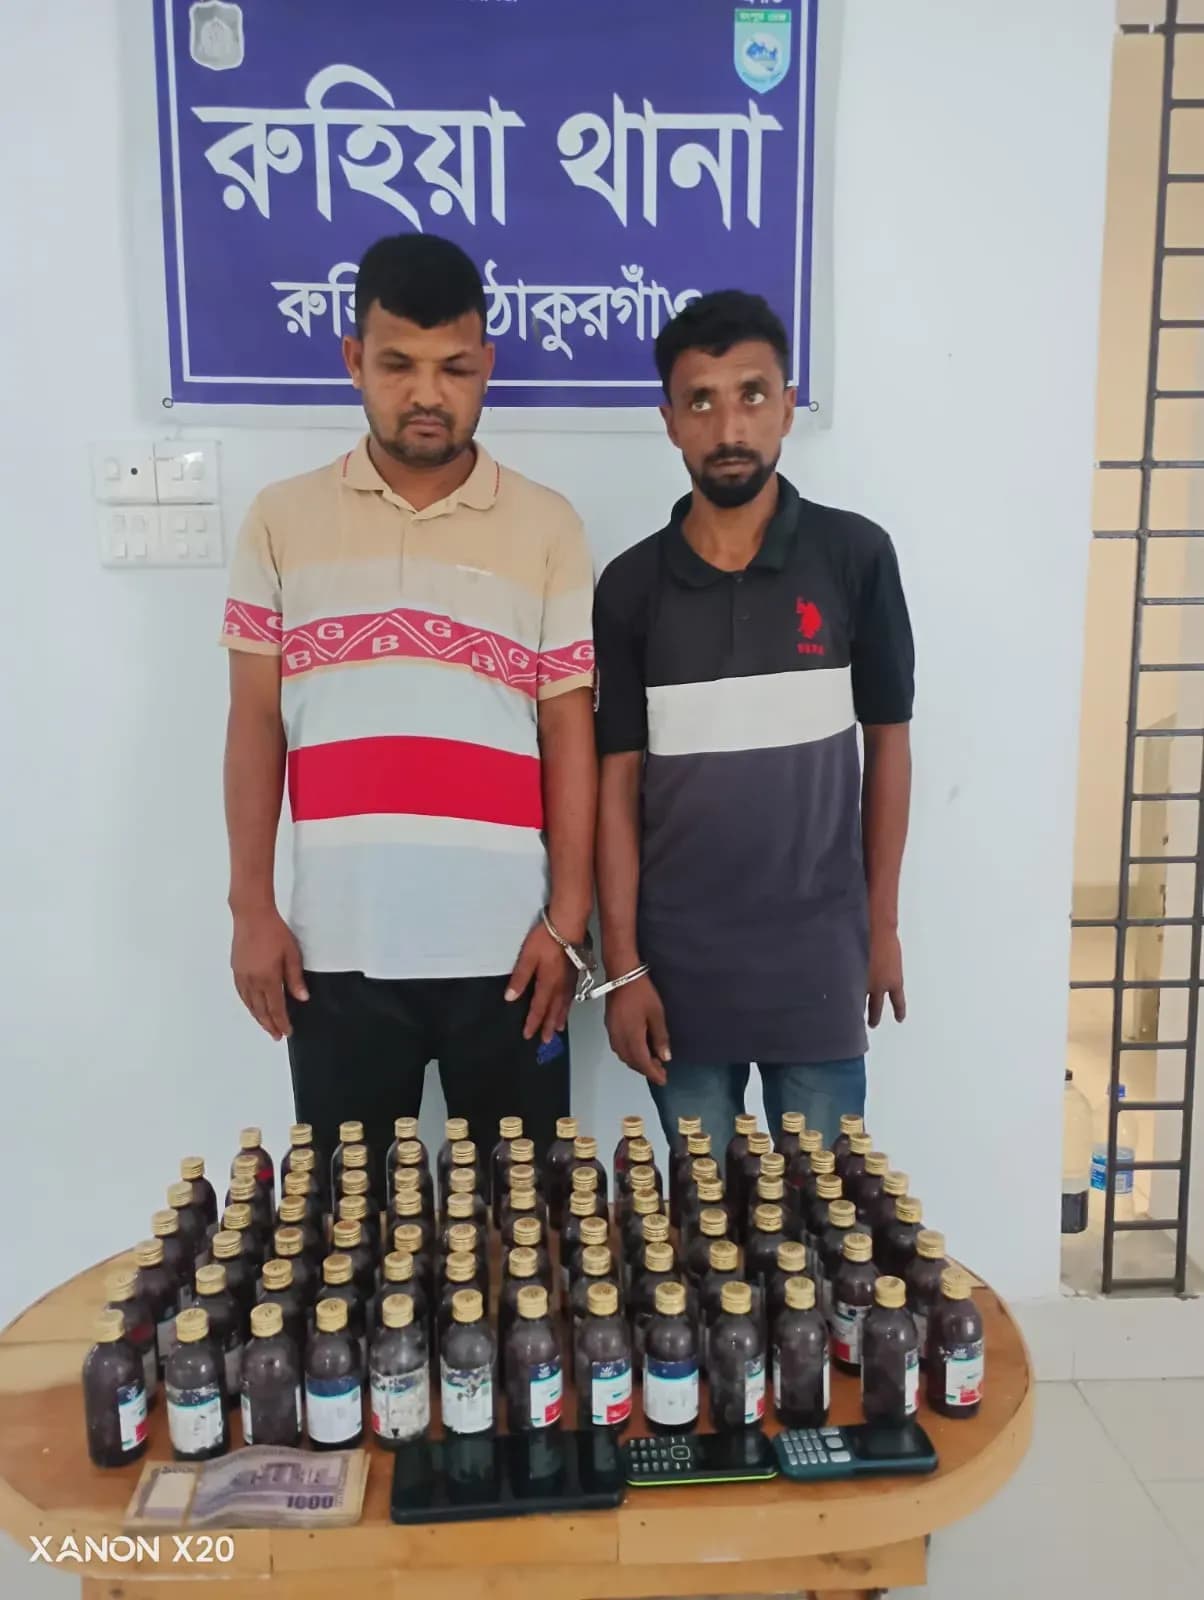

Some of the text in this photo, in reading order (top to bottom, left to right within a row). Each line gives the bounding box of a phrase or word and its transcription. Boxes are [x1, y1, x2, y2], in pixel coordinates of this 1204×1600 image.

[191, 63, 783, 232] রুহিয়া থানা
[286, 619, 529, 672] B G B G B G
[572, 644, 594, 661] G
